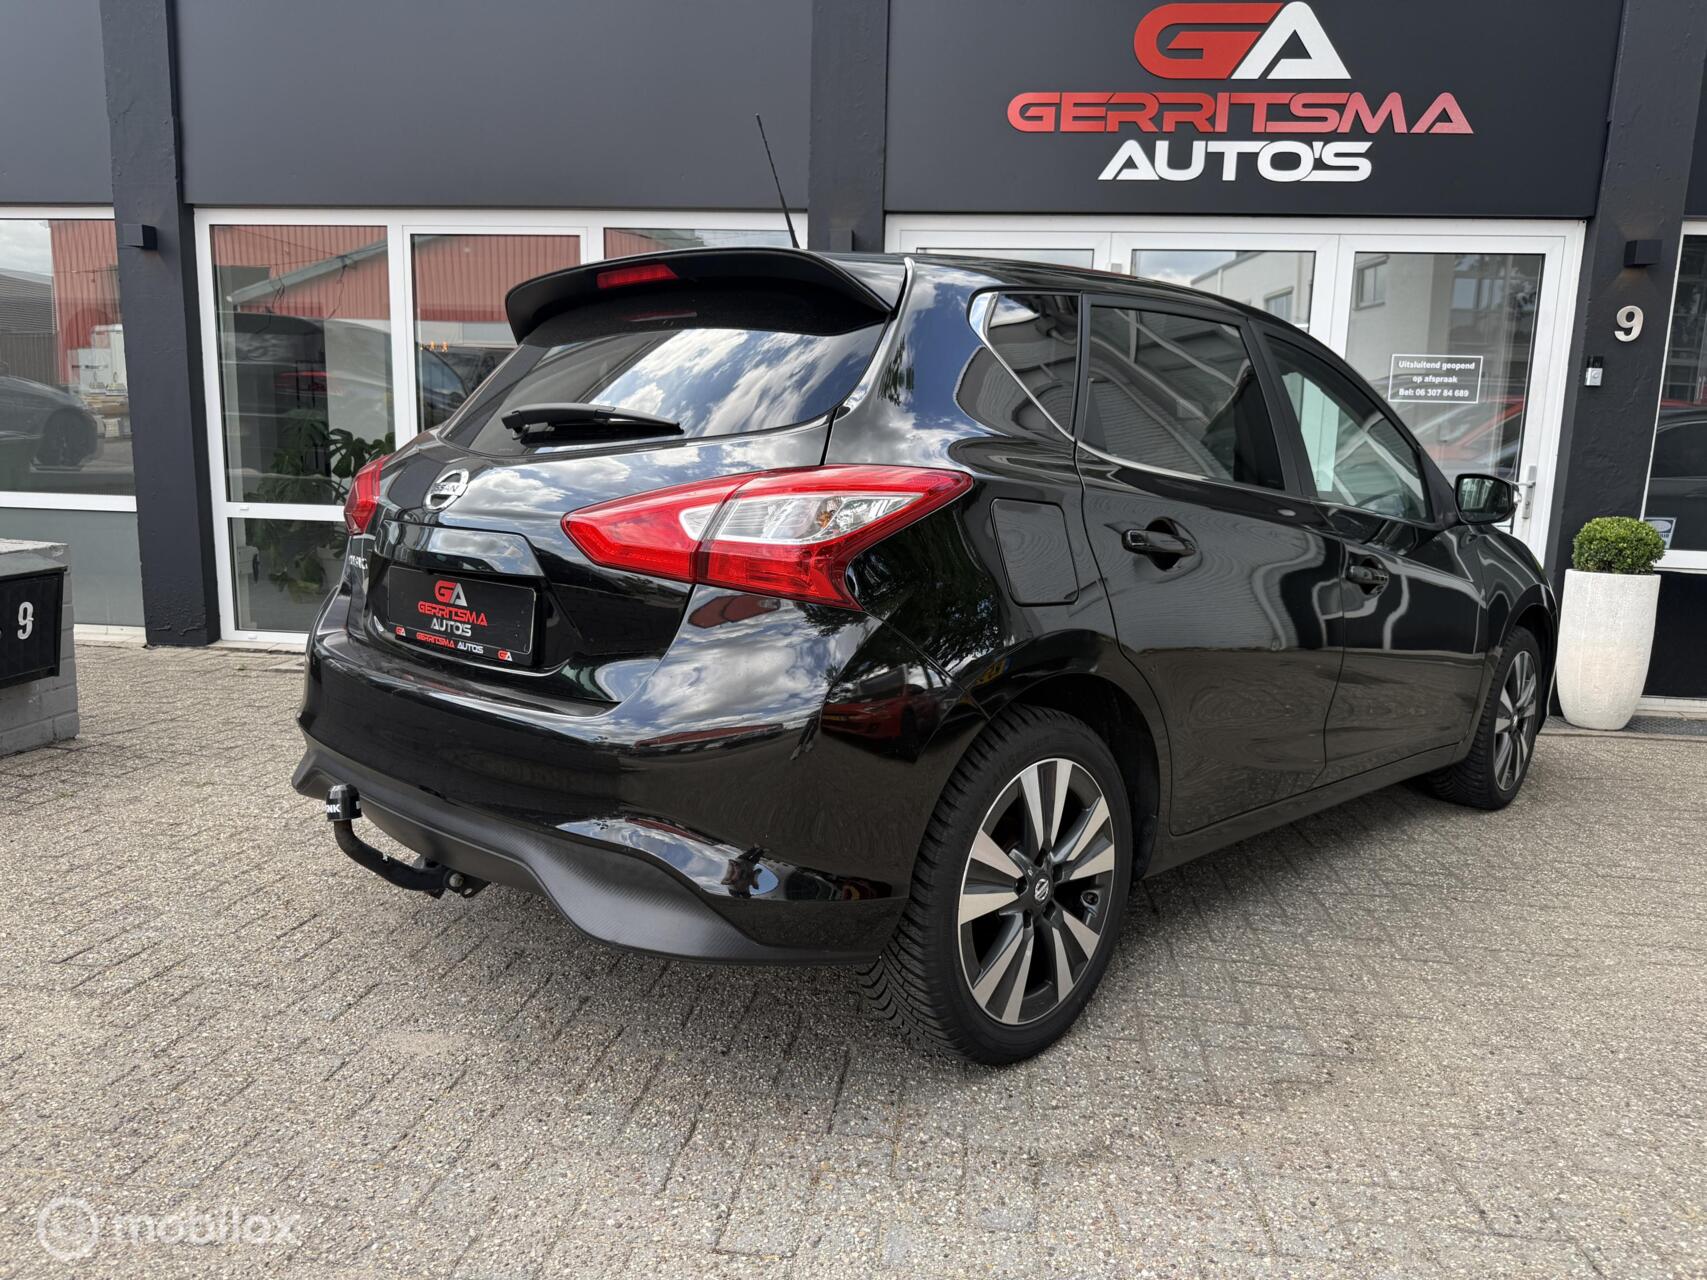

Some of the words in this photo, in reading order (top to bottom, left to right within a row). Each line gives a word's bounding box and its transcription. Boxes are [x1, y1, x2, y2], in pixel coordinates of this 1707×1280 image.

[1133, 0, 1352, 79] GA
[1006, 91, 1475, 134] GERRITSMA
[1097, 139, 1374, 182] AUTO'S
[1614, 305, 1644, 342] 9
[1398, 360, 1441, 369] Uitsluitend
[1441, 362, 1475, 371] geopend
[1412, 376, 1422, 384] op
[1423, 375, 1458, 384] afspraak
[1415, 388, 1425, 397] 06
[1427, 389, 1441, 397] 307
[434, 579, 468, 607] GA
[17, 601, 34, 640] 9
[417, 600, 489, 627] GERRITSMA
[416, 632, 456, 649] GERRITSMA
